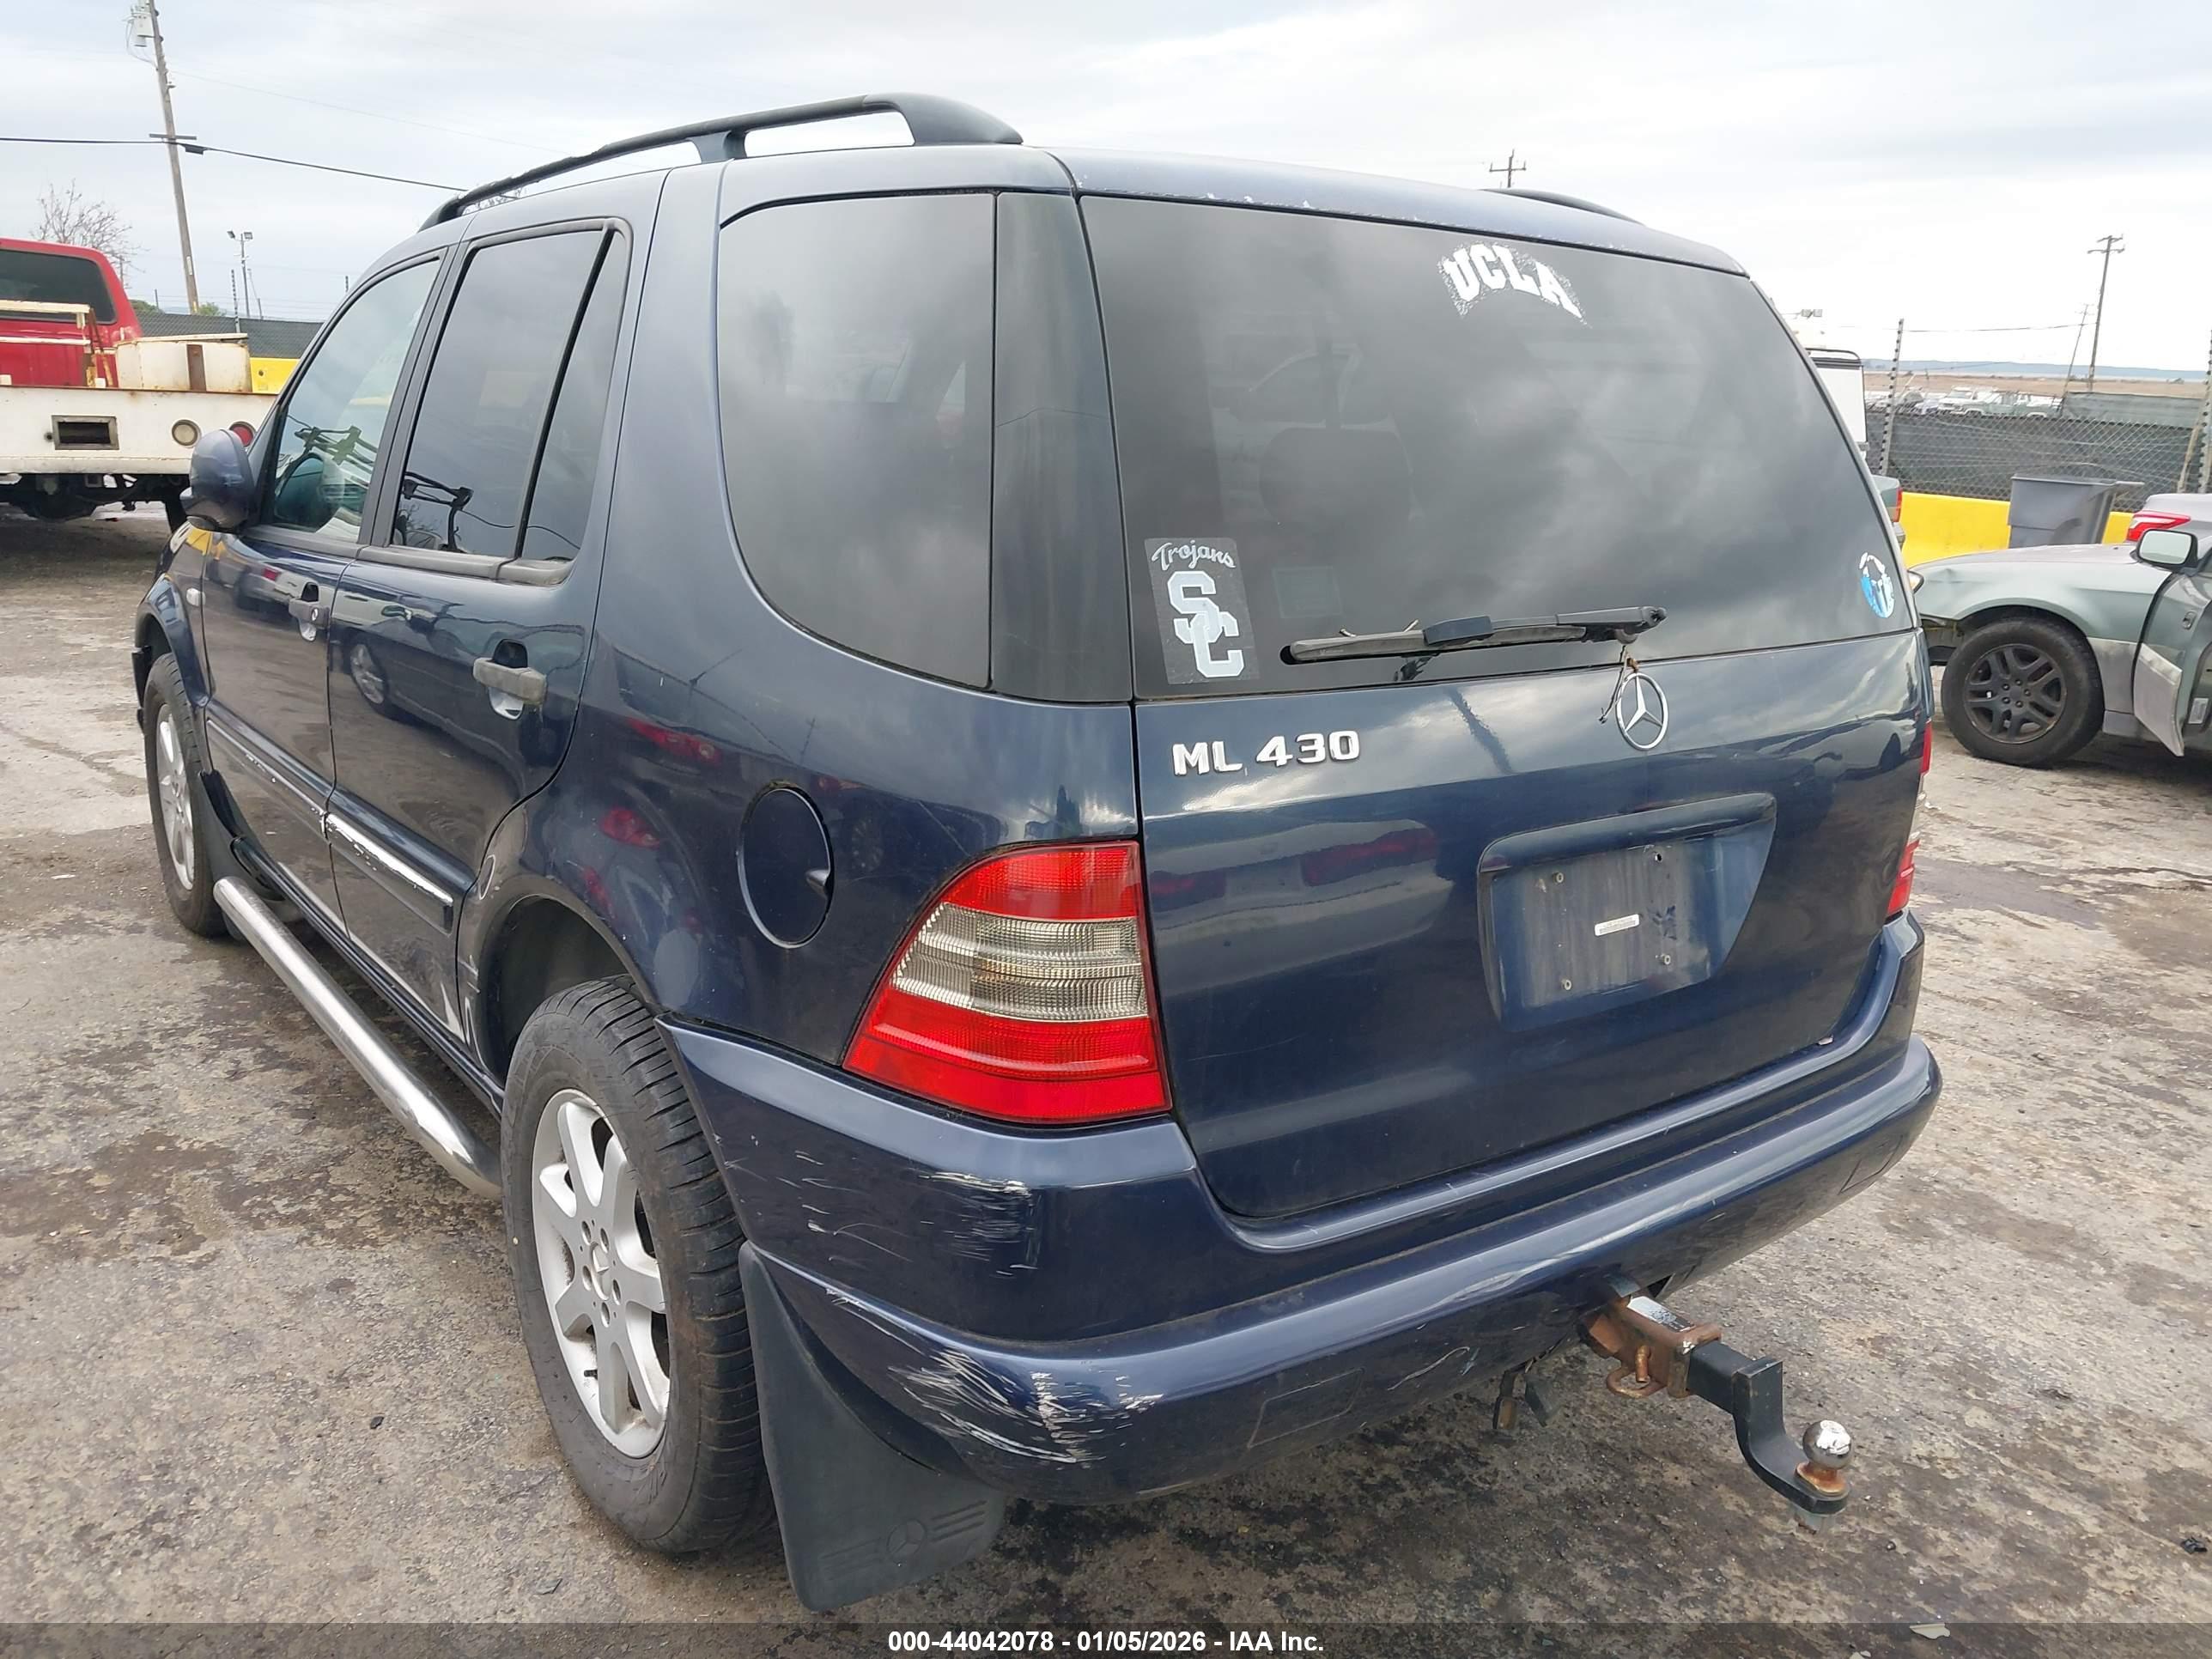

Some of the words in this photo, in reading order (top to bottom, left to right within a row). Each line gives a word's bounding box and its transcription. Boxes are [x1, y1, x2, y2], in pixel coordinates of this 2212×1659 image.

[1442, 243, 1583, 319] UCLA
[1152, 540, 1237, 570] Trojans
[1167, 570, 1245, 678] SC
[1172, 740, 1244, 776] ML
[1256, 730, 1361, 768] 430
